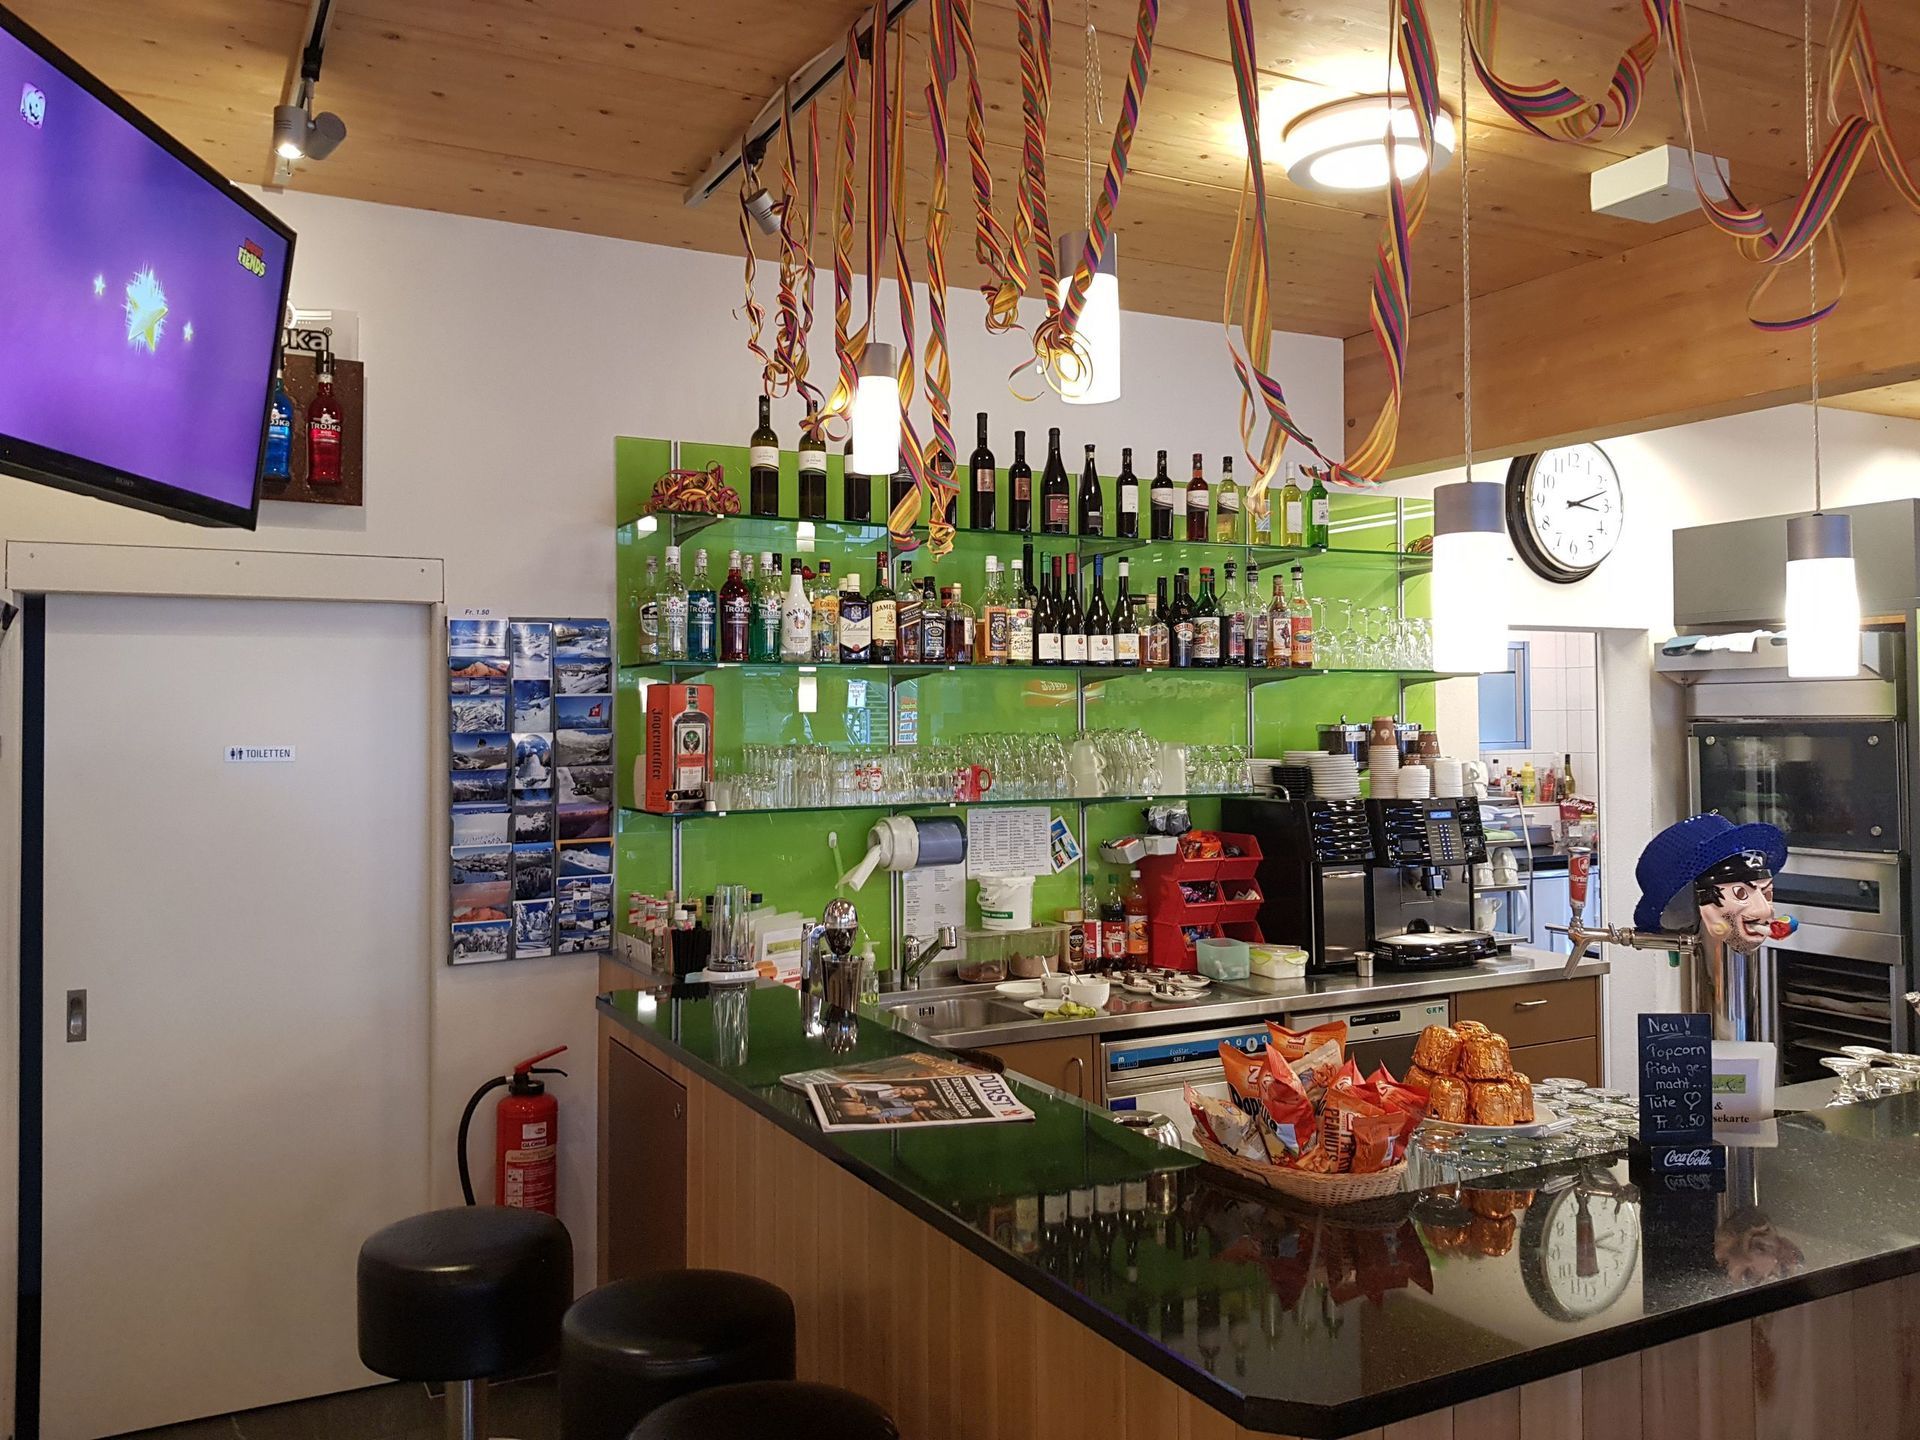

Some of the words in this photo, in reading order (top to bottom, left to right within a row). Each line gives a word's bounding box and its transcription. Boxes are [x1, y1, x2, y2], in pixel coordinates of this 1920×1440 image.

[1554, 457, 1563, 473] 11
[1568, 452, 1580, 468] 12
[1543, 474, 1555, 489] 10
[1536, 492, 1546, 508] 9
[1541, 515, 1551, 531] 8
[245, 749, 291, 758] TOILETTEN
[1645, 1060, 1681, 1079] frisch
[1686, 1063, 1707, 1077] ge-
[1644, 1095, 1677, 1110] Tüte
[1714, 1101, 1723, 1110] &
[1713, 1114, 1749, 1123] sekarte
[1324, 1108, 1340, 1162] PEANUTS
[1664, 1149, 1712, 1166] Coca-Cola
